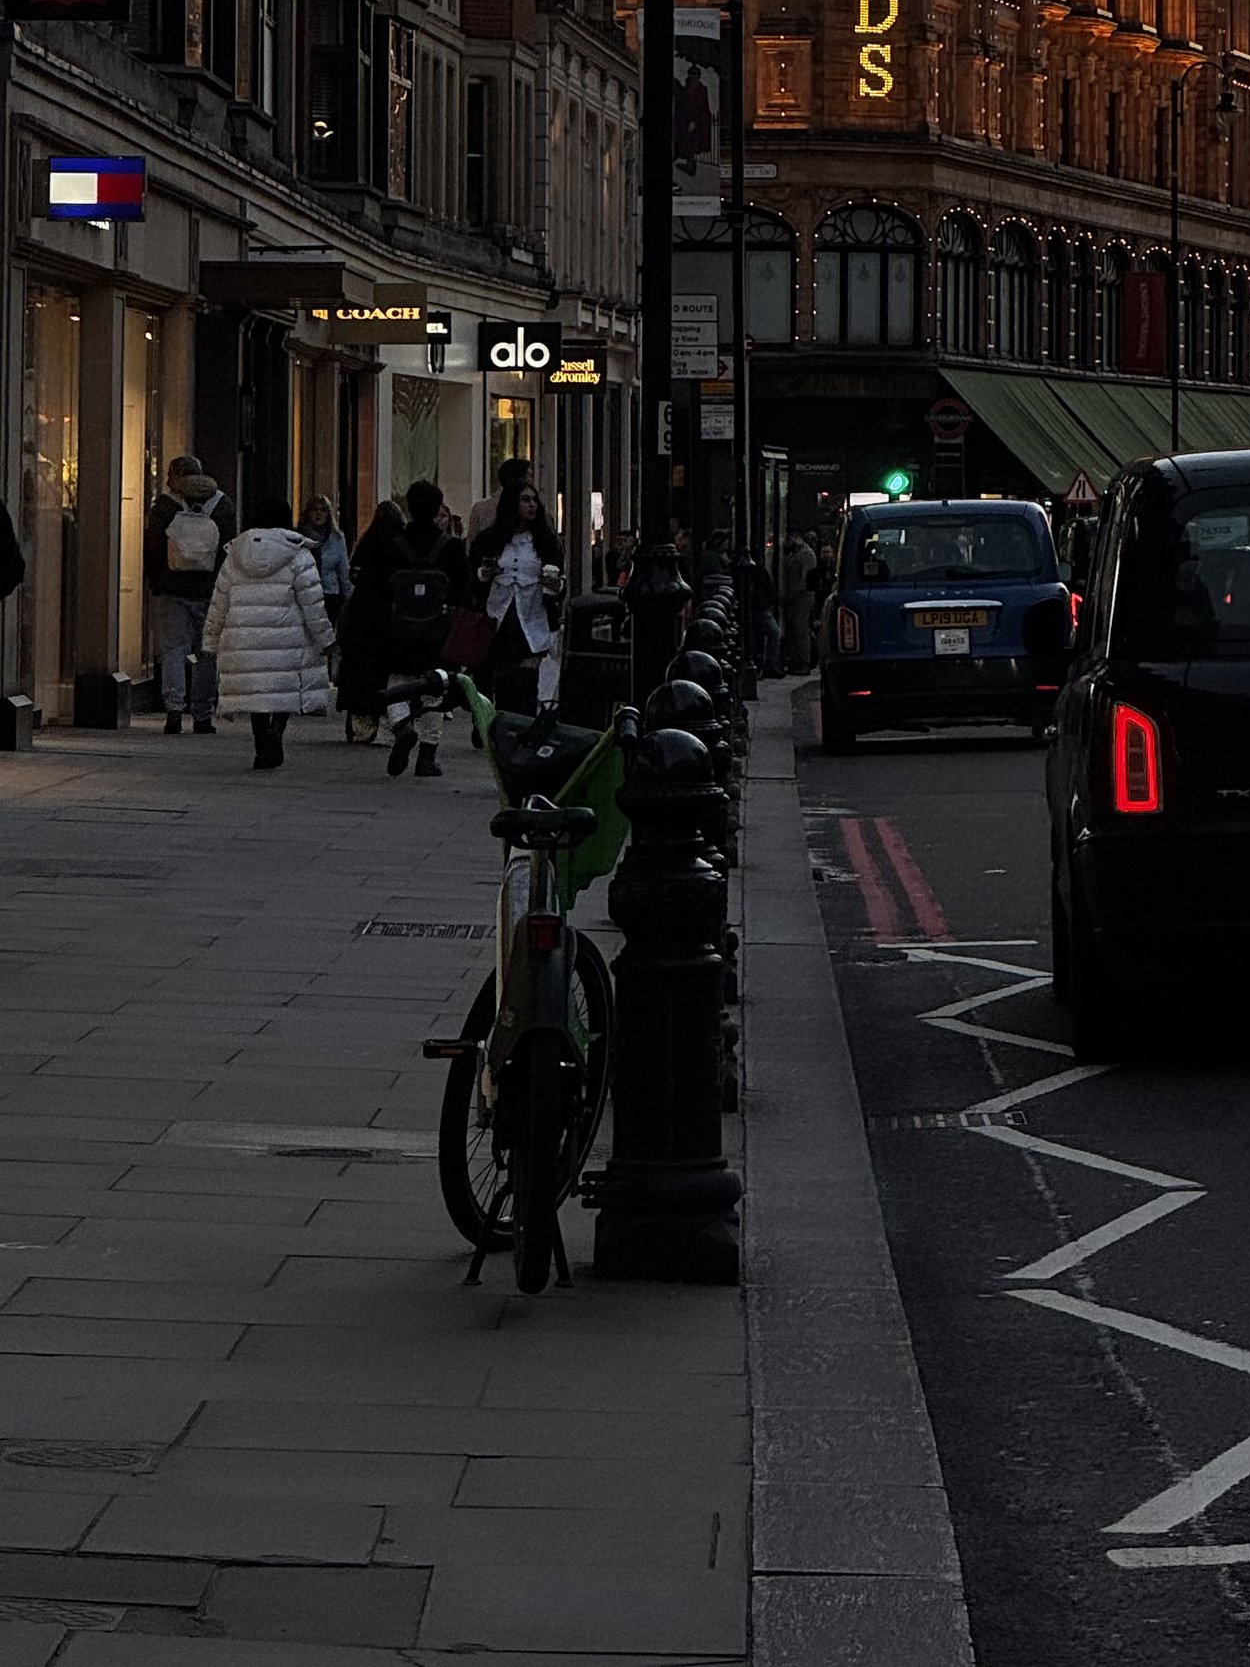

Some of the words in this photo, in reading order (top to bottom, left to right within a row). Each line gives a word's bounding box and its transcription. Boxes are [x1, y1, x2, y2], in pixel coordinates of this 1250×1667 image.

[336, 307, 420, 320] COACH
[427, 323, 448, 334] EL
[490, 326, 550, 368] alo
[922, 612, 951, 626] LP19
[954, 611, 980, 625] UGA
